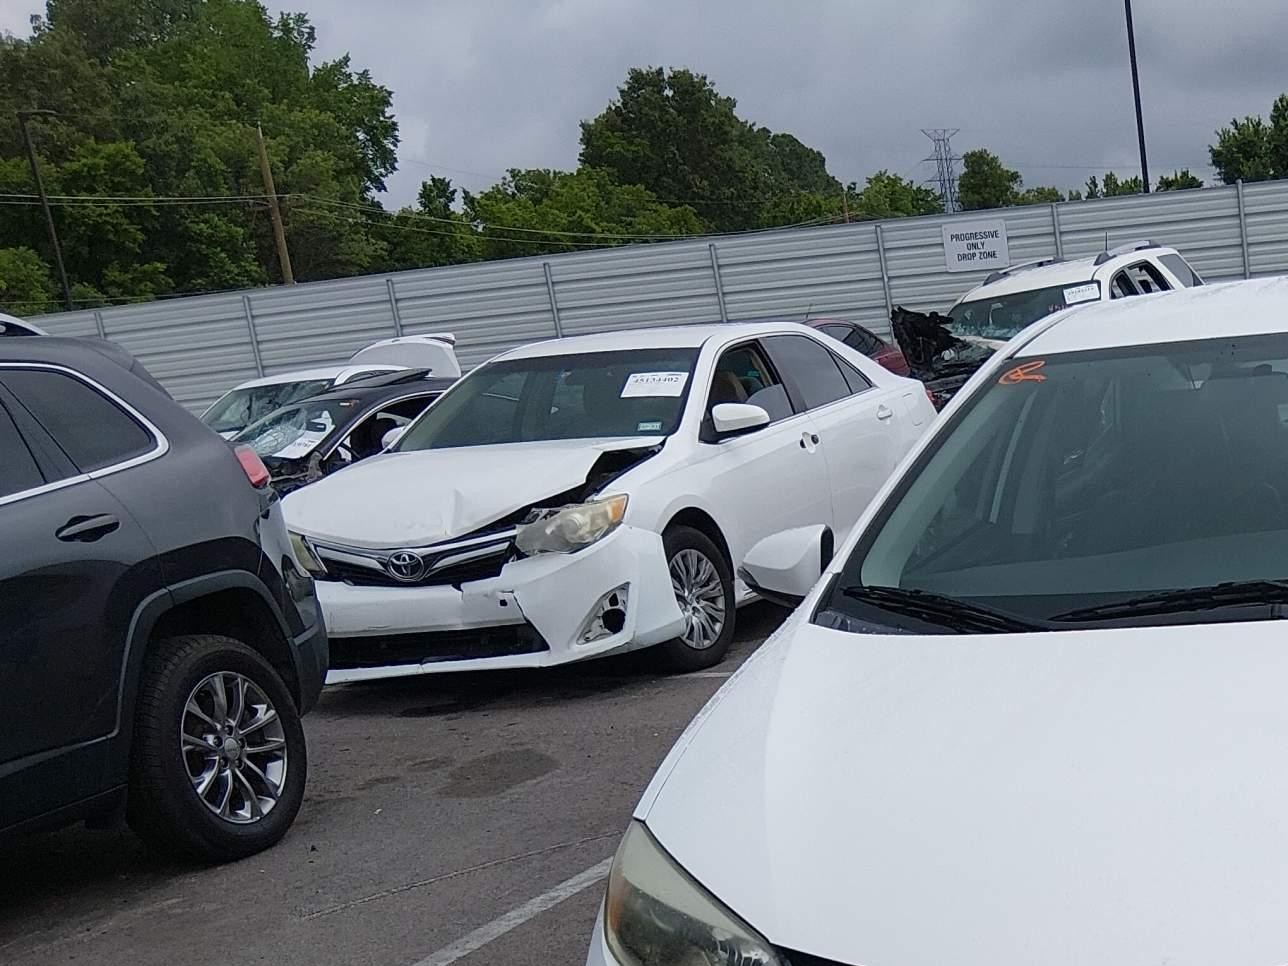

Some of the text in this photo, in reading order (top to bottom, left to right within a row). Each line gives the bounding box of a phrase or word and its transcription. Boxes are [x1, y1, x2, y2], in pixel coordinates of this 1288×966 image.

[950, 230, 1000, 242] PROGRESSIVE
[966, 241, 985, 251] ONLY
[957, 250, 998, 262] DROP ZONE
